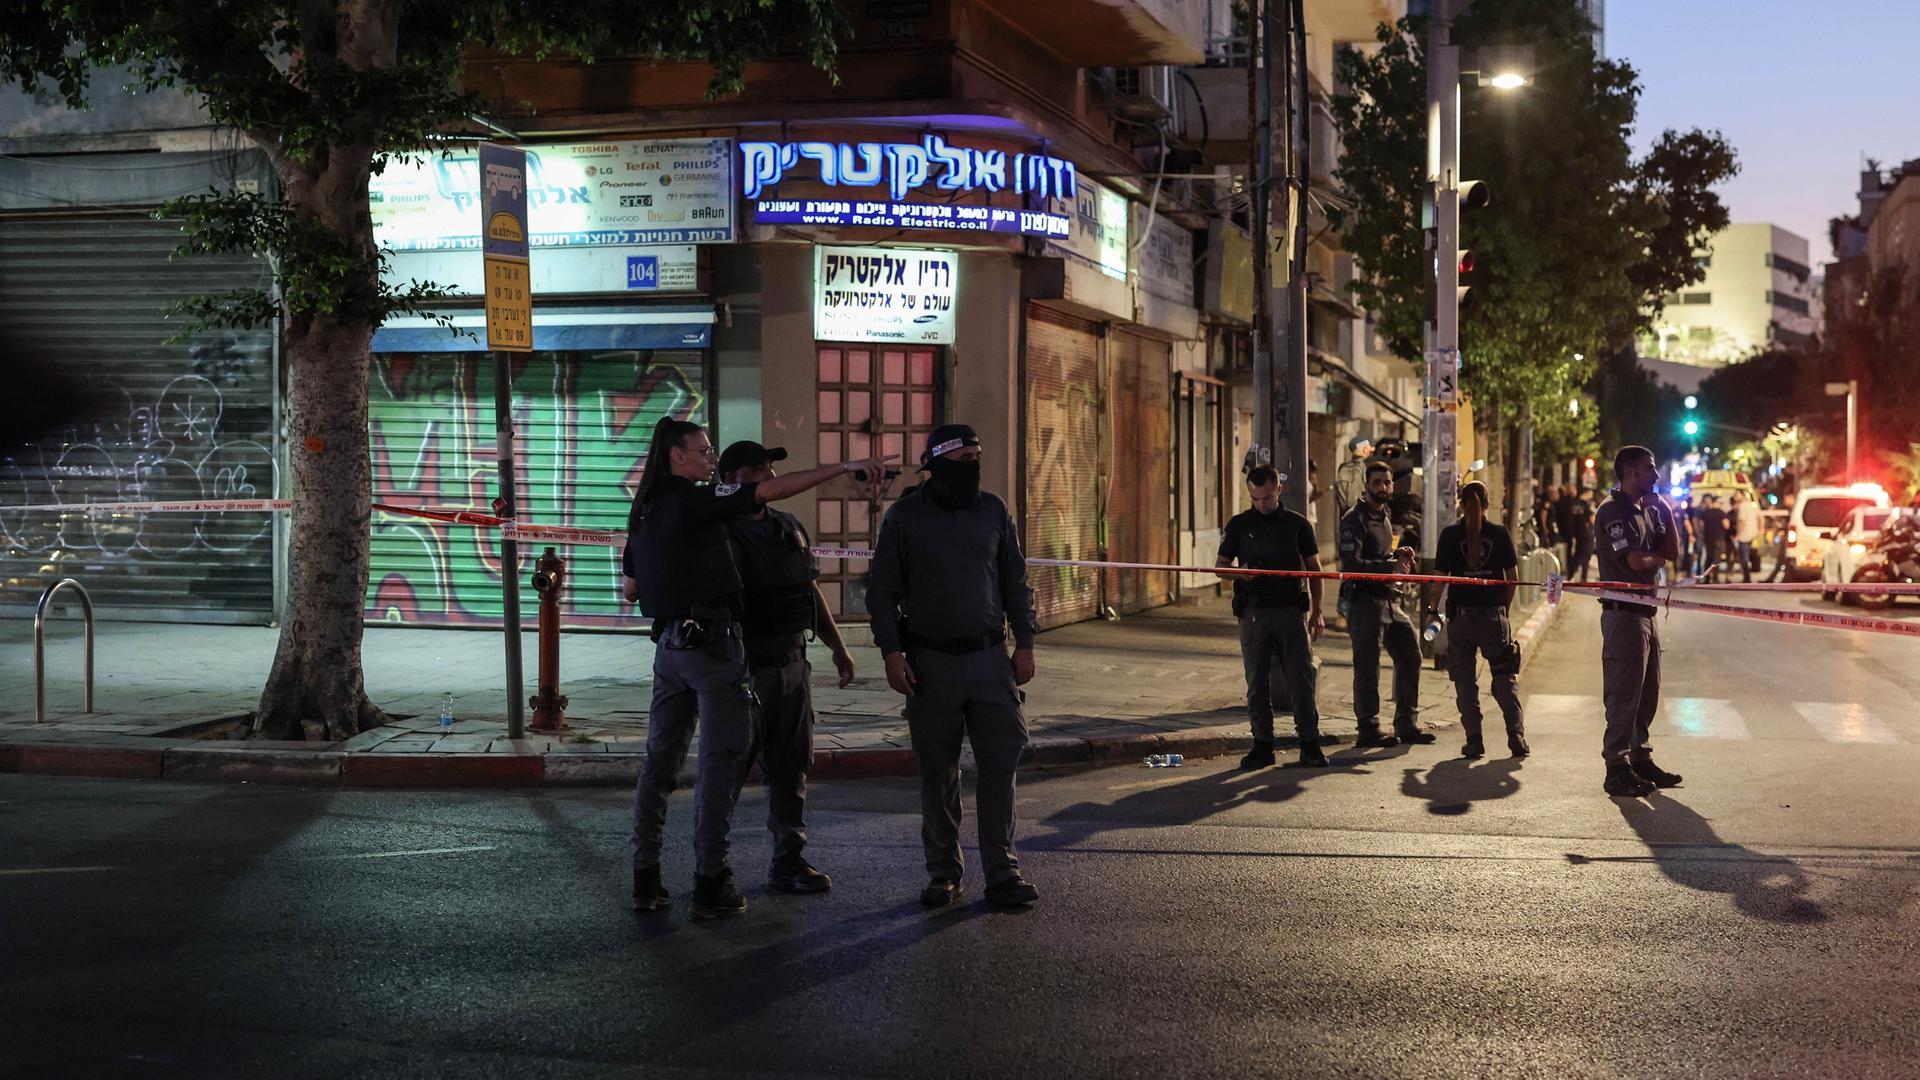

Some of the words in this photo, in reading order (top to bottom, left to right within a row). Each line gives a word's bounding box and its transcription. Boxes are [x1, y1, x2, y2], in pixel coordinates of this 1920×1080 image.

[571, 145, 619, 153] TOSHIBA
[626, 161, 662, 171] Tefal
[673, 160, 719, 170] PHILIPS
[739, 134, 1006, 200] אלקטריק
[600, 180, 648, 188] Pioneer
[802, 215, 845, 224] www.
[852, 215, 895, 226] Radio
[528, 233, 570, 246] חשמ
[576, 231, 628, 244] למוצרי
[634, 231, 682, 243] חנויות
[688, 231, 726, 241] רשת
[1274, 236, 1284, 252] 7
[630, 263, 655, 281] 104
[825, 254, 906, 287] אלקטריק
[918, 259, 950, 287] רדיו
[824, 290, 892, 309] אלקטרוניקה
[901, 292, 916, 310] של
[923, 293, 950, 311] עולם
[866, 329, 905, 338] Panasonic
[921, 331, 938, 340] JVC
[543, 532, 567, 541] ישראל
[582, 534, 611, 543] משטרת
